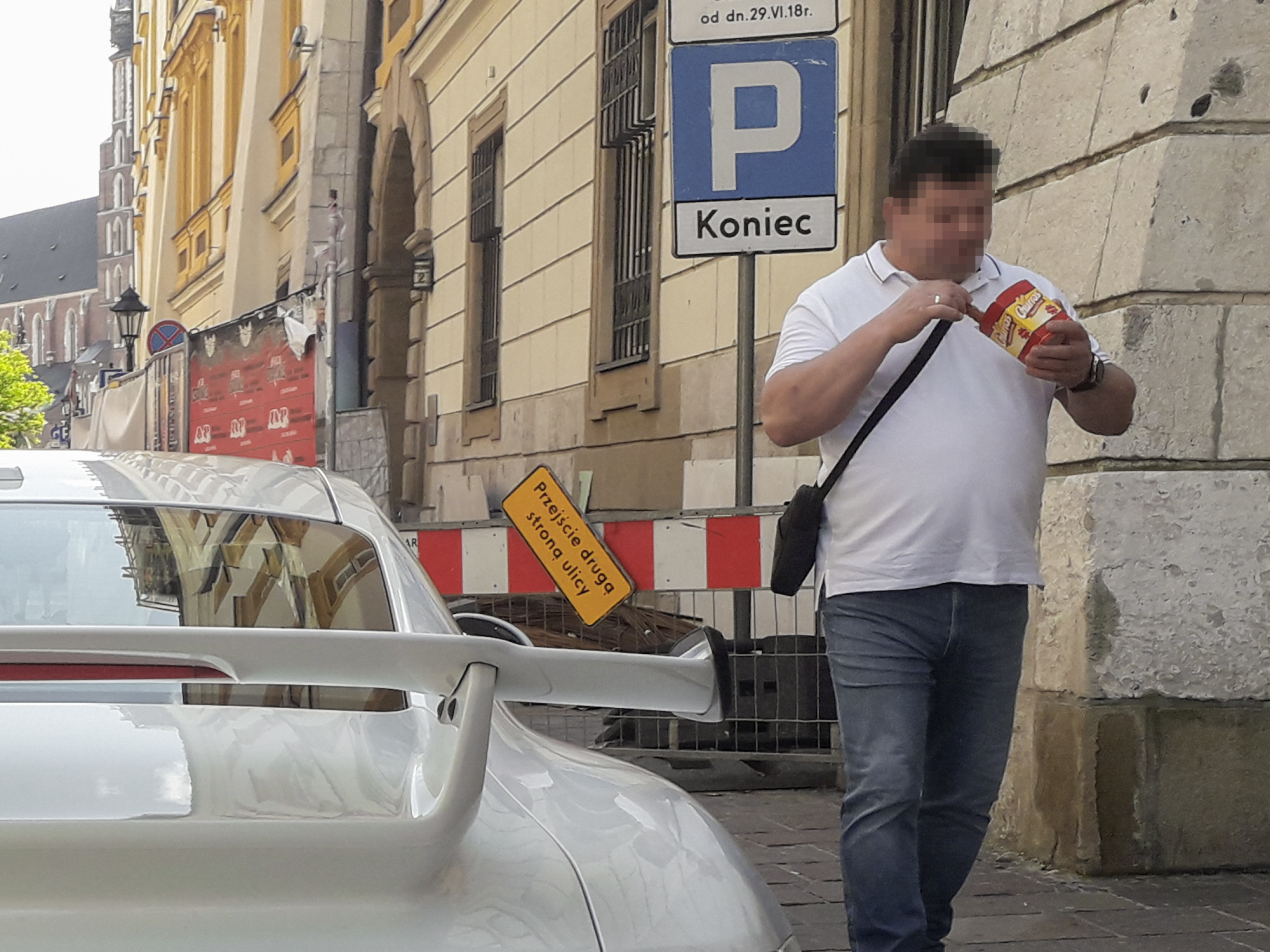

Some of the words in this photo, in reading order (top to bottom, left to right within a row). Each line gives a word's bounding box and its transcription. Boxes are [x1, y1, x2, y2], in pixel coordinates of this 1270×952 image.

[701, 10, 719, 24] od
[710, 60, 802, 192] P
[697, 207, 812, 239] Koniec
[526, 512, 563, 561] stroną
[562, 560, 590, 598] ulicy
[534, 481, 581, 547] Przejście
[581, 549, 615, 596] drugą
